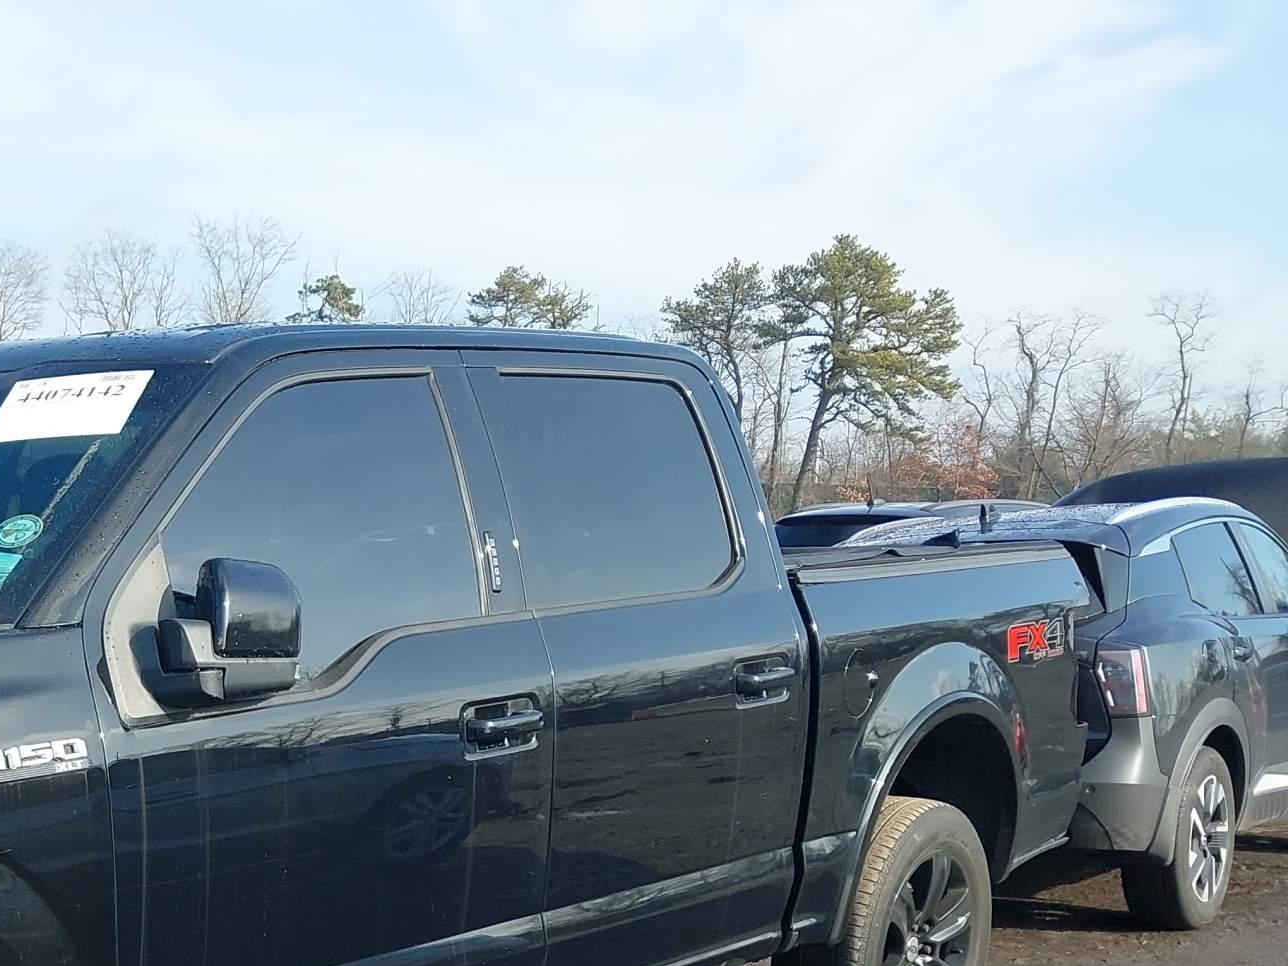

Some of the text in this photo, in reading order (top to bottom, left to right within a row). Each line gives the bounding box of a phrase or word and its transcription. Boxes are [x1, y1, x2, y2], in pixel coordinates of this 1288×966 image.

[18, 383, 126, 404] 44074142
[1008, 617, 1065, 663] FX4
[56, 759, 88, 773] XLT
